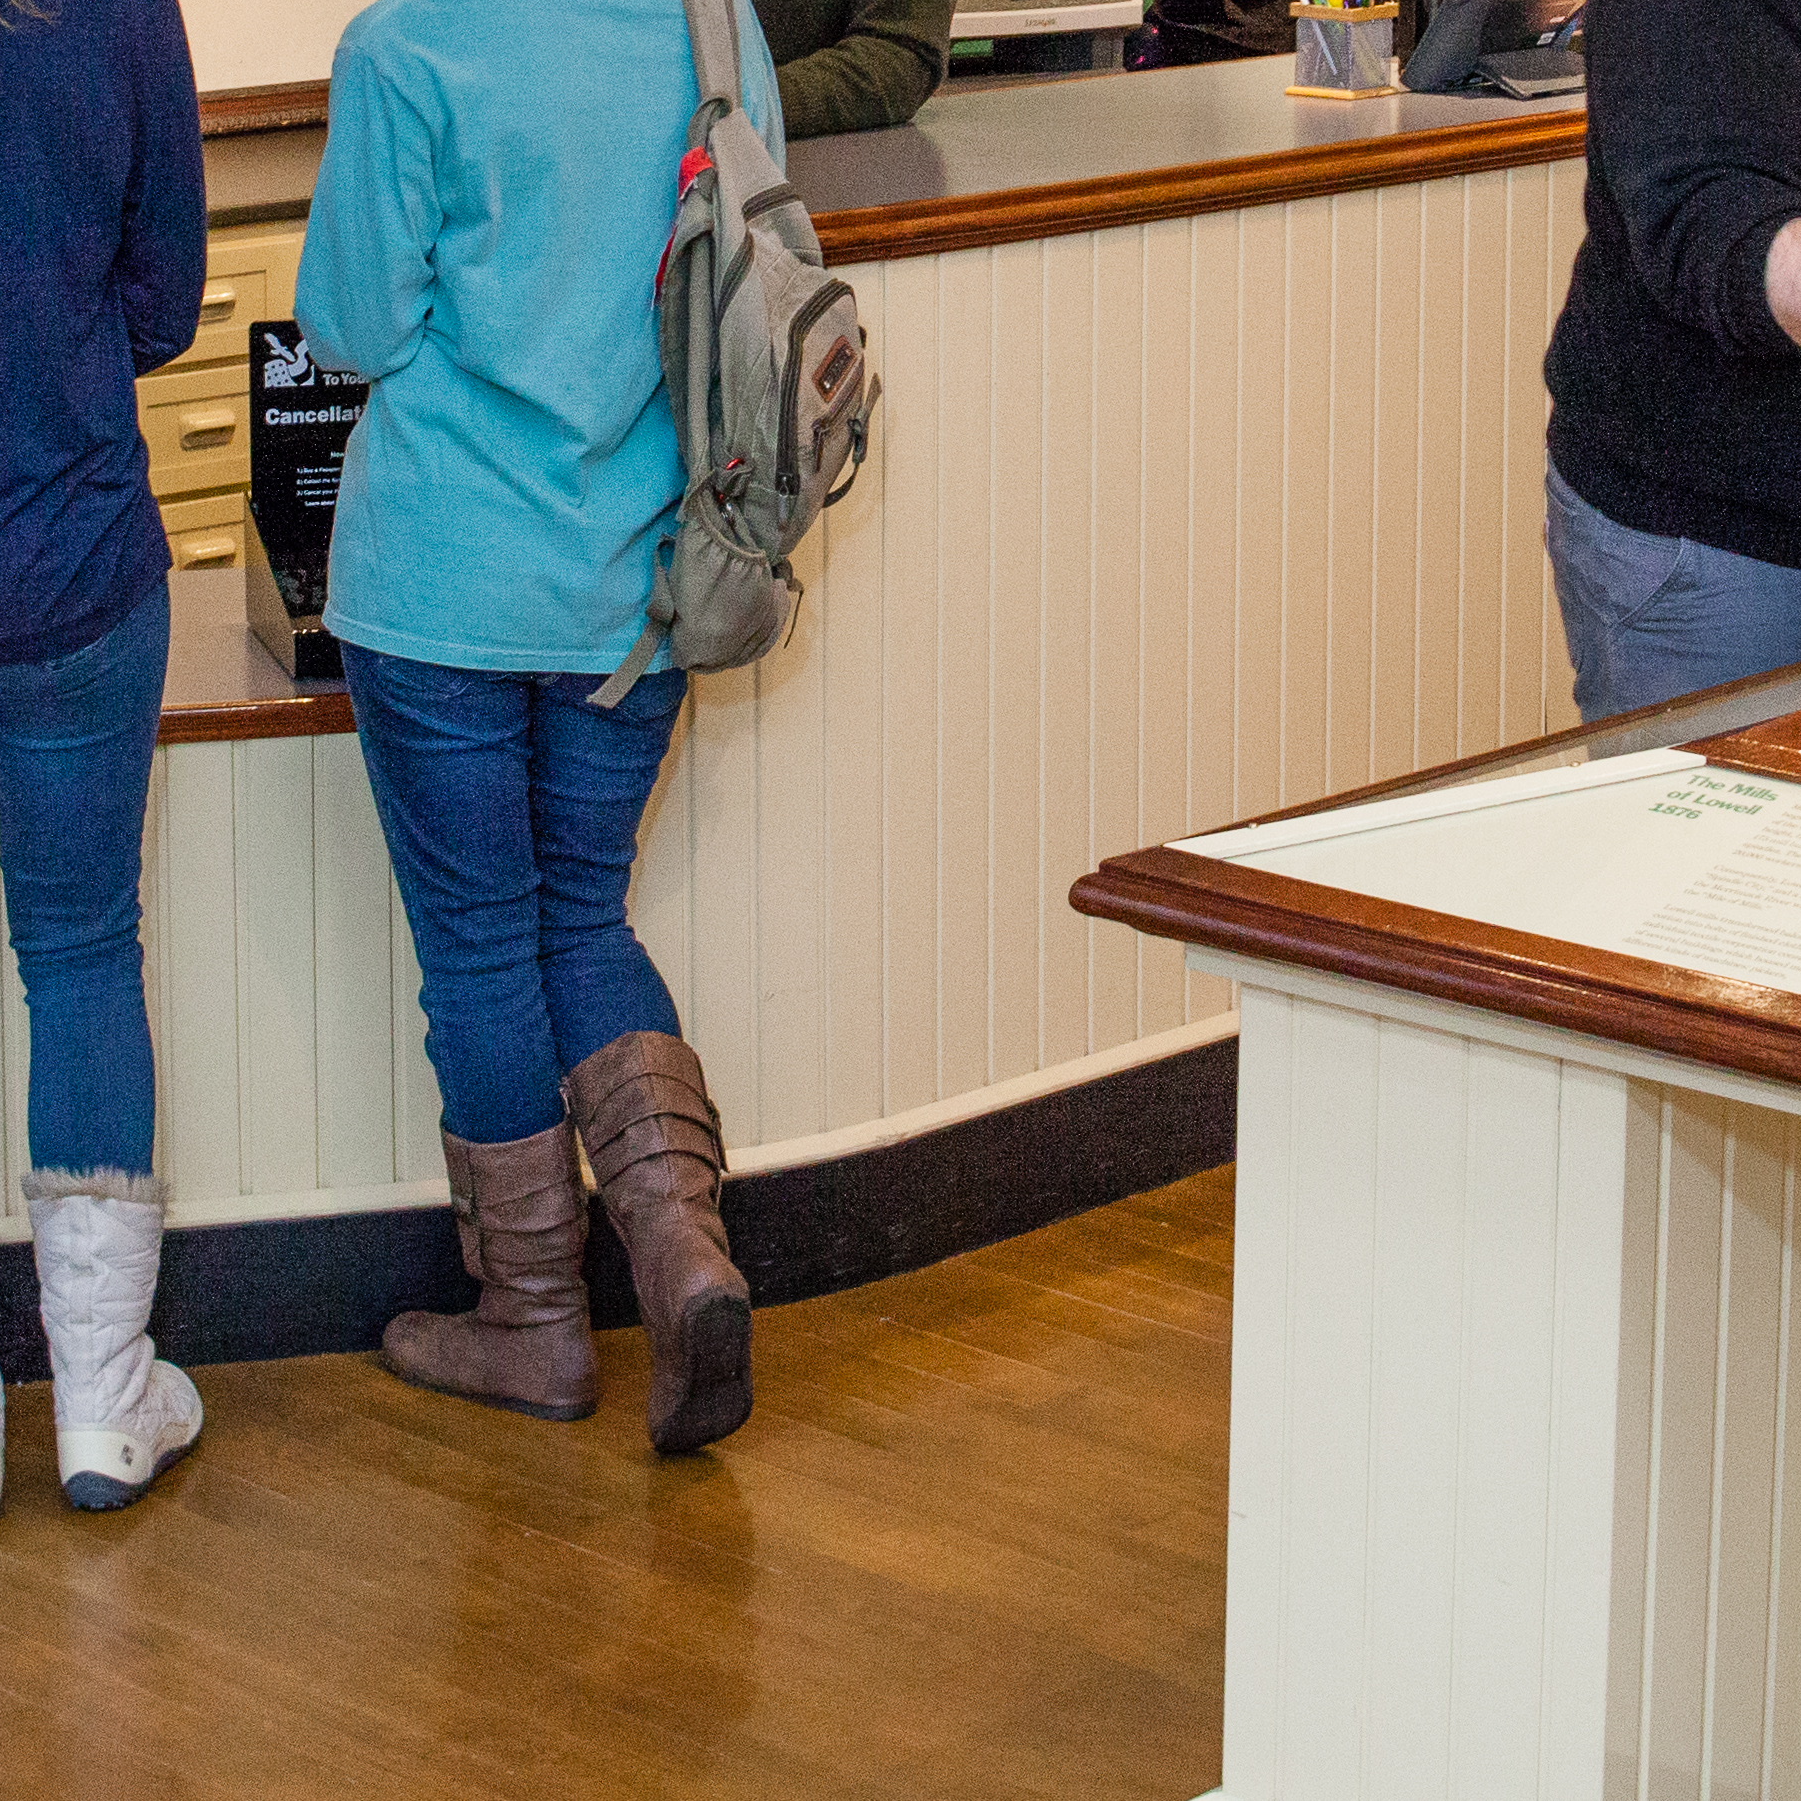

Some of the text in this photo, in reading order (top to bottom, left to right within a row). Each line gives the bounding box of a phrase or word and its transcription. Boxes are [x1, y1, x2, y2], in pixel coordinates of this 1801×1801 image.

[323, 373, 339, 386] To
[1687, 774, 1779, 802] The Mills
[1648, 802, 1703, 819] 1876
[1667, 790, 1763, 815] of Lowell
